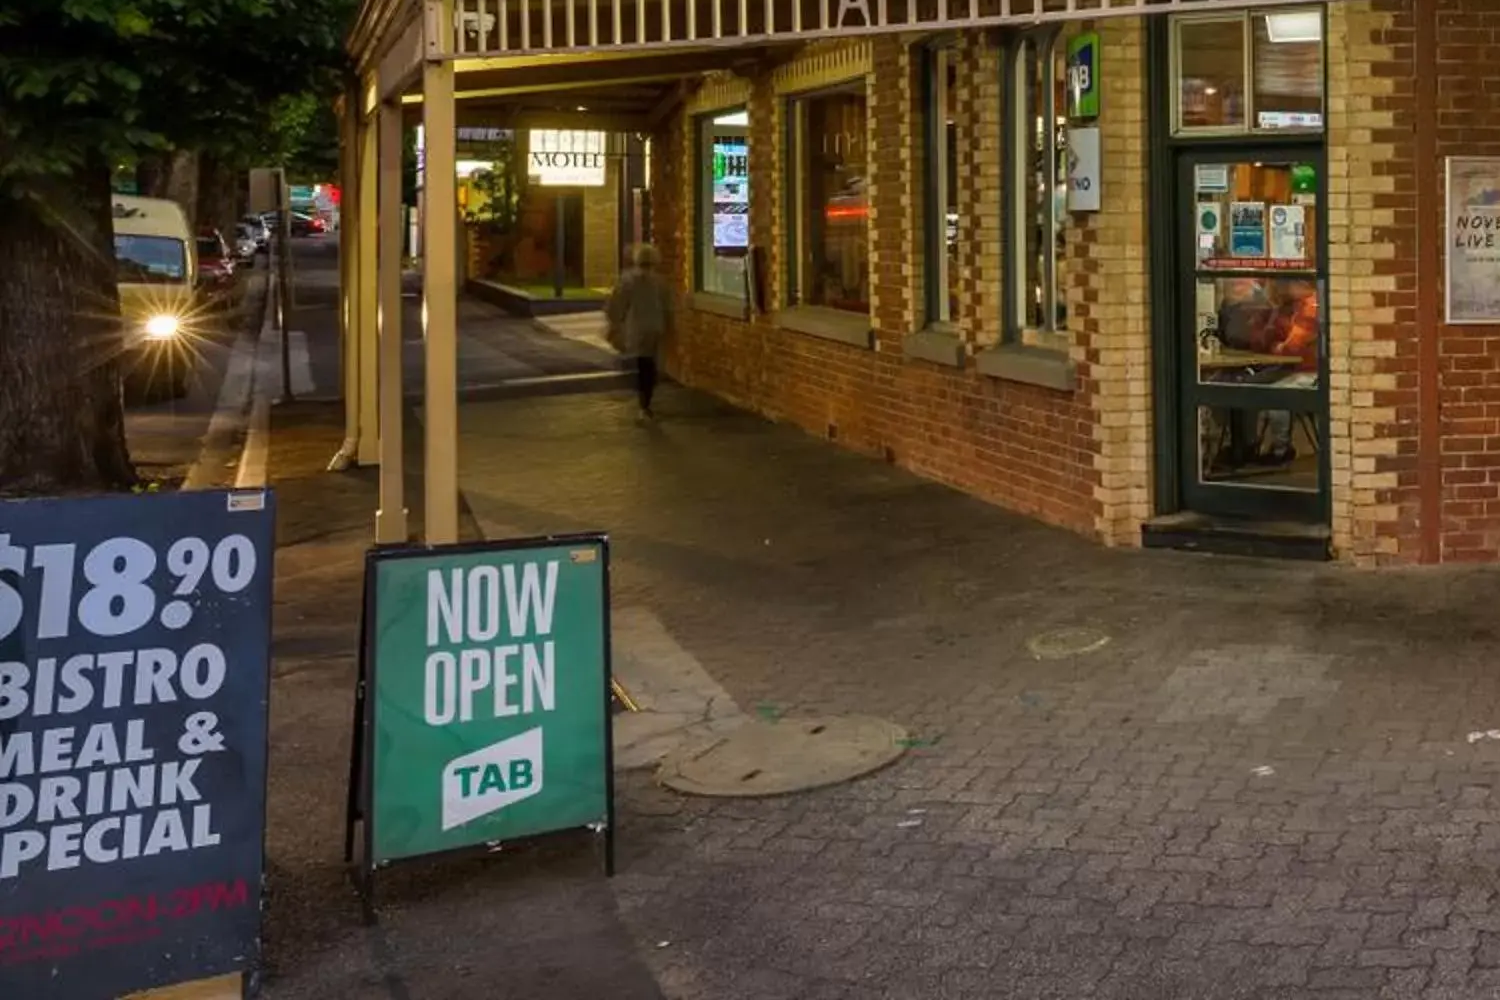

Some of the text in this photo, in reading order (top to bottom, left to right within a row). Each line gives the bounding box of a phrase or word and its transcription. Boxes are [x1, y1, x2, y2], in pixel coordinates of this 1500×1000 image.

[532, 152, 603, 169] MOTEL
[1455, 233, 1495, 249] LIVE
[427, 561, 559, 646] NOW
[0, 643, 226, 720] BISTRO
[425, 641, 555, 725] OPEN
[178, 711, 226, 755] &
[0, 758, 202, 828] DRINK
[454, 758, 533, 798] TAB
[0, 804, 220, 879] PECIAL
